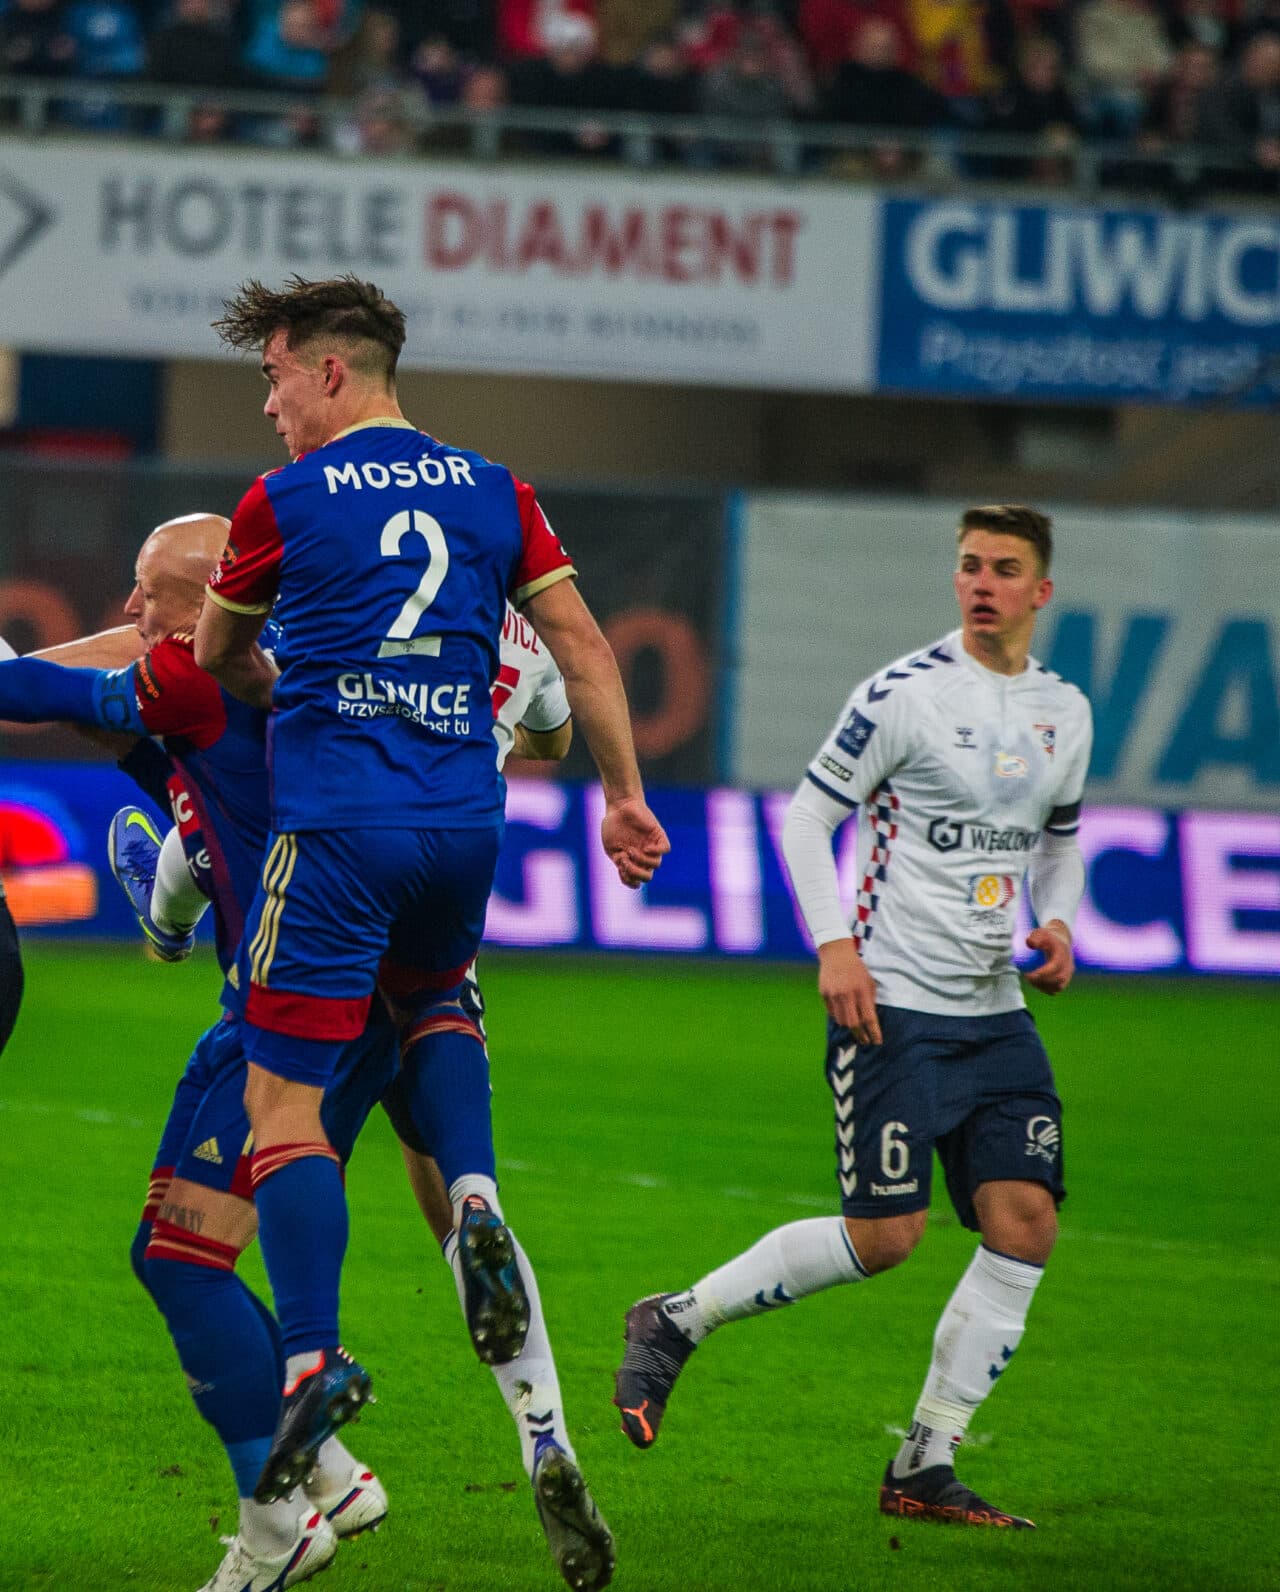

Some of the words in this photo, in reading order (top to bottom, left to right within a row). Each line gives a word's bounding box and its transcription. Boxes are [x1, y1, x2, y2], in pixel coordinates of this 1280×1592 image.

[98, 172, 406, 270] HOTELE
[423, 188, 804, 292] DIAMENT
[323, 452, 477, 495] MOSÓR
[377, 508, 450, 659] 2
[881, 1120, 910, 1180] 6
